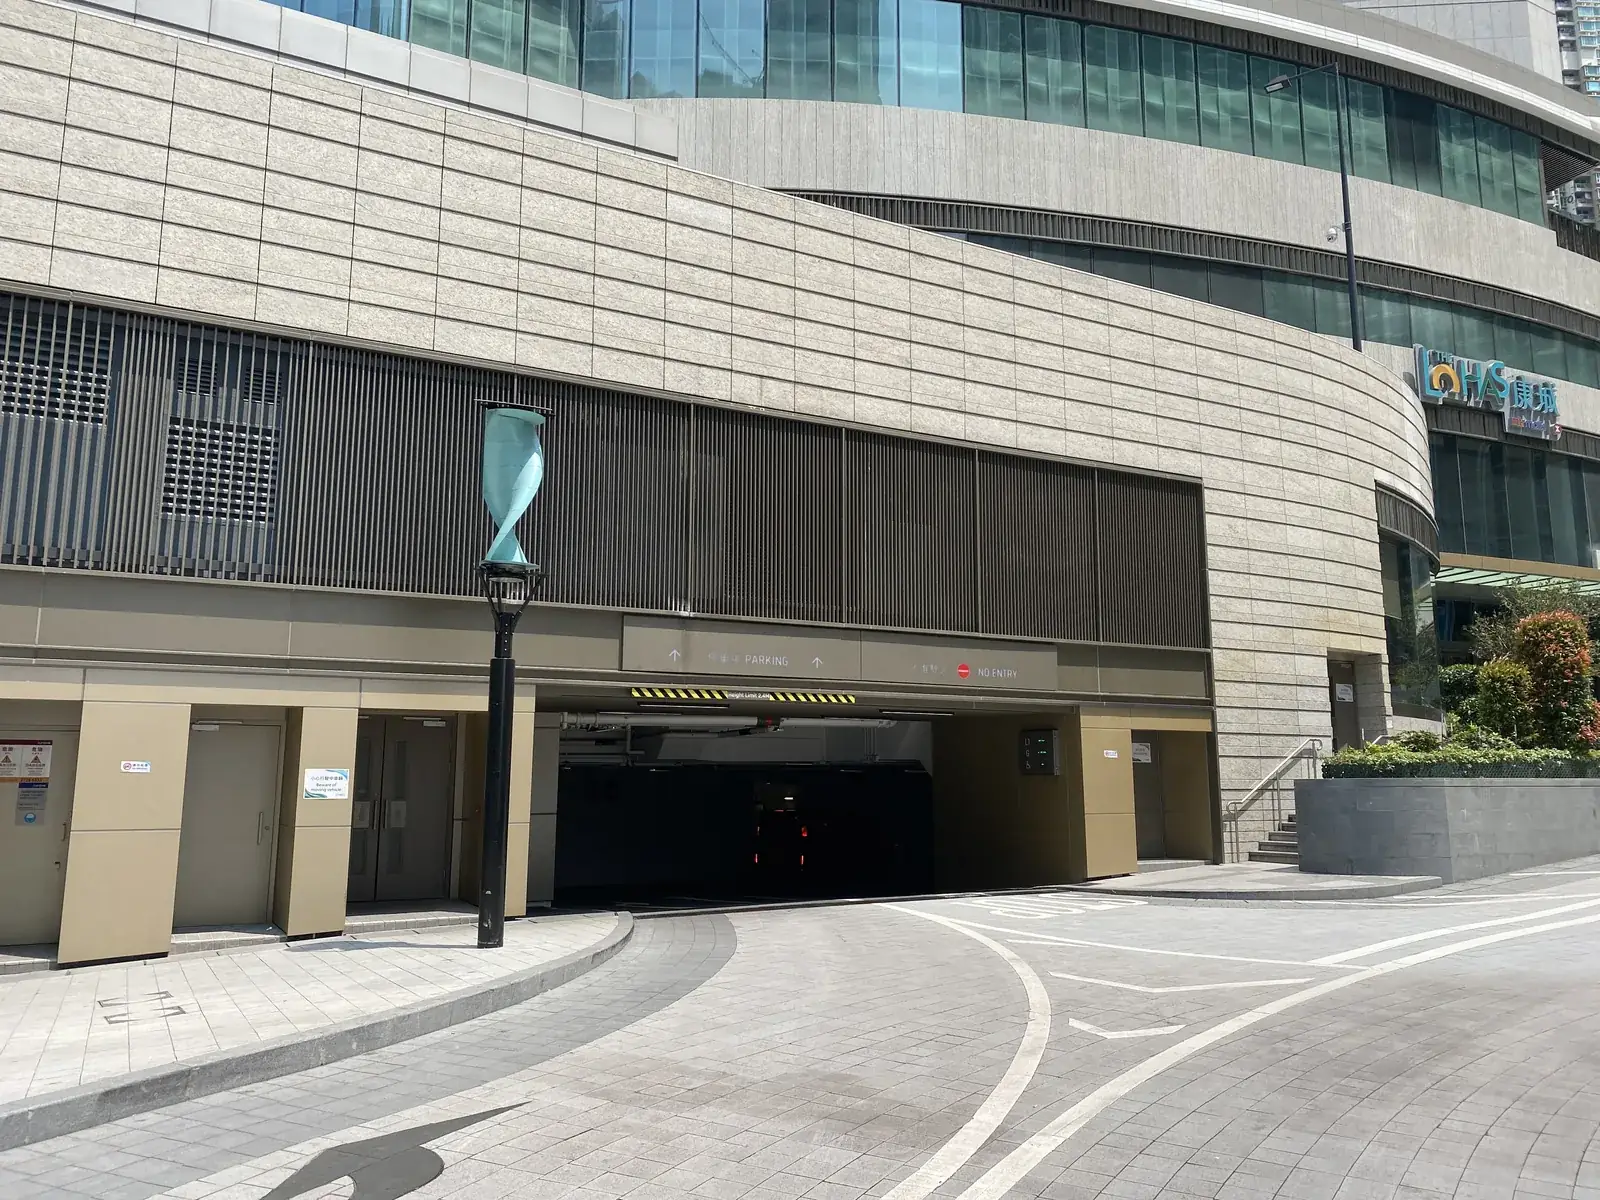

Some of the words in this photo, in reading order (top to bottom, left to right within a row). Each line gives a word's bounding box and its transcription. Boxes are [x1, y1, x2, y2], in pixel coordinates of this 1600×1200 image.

[1514, 380, 1560, 416] 康城
[745, 654, 789, 667] PARKING
[978, 667, 990, 678] NO
[992, 668, 1018, 679] ENTRY
